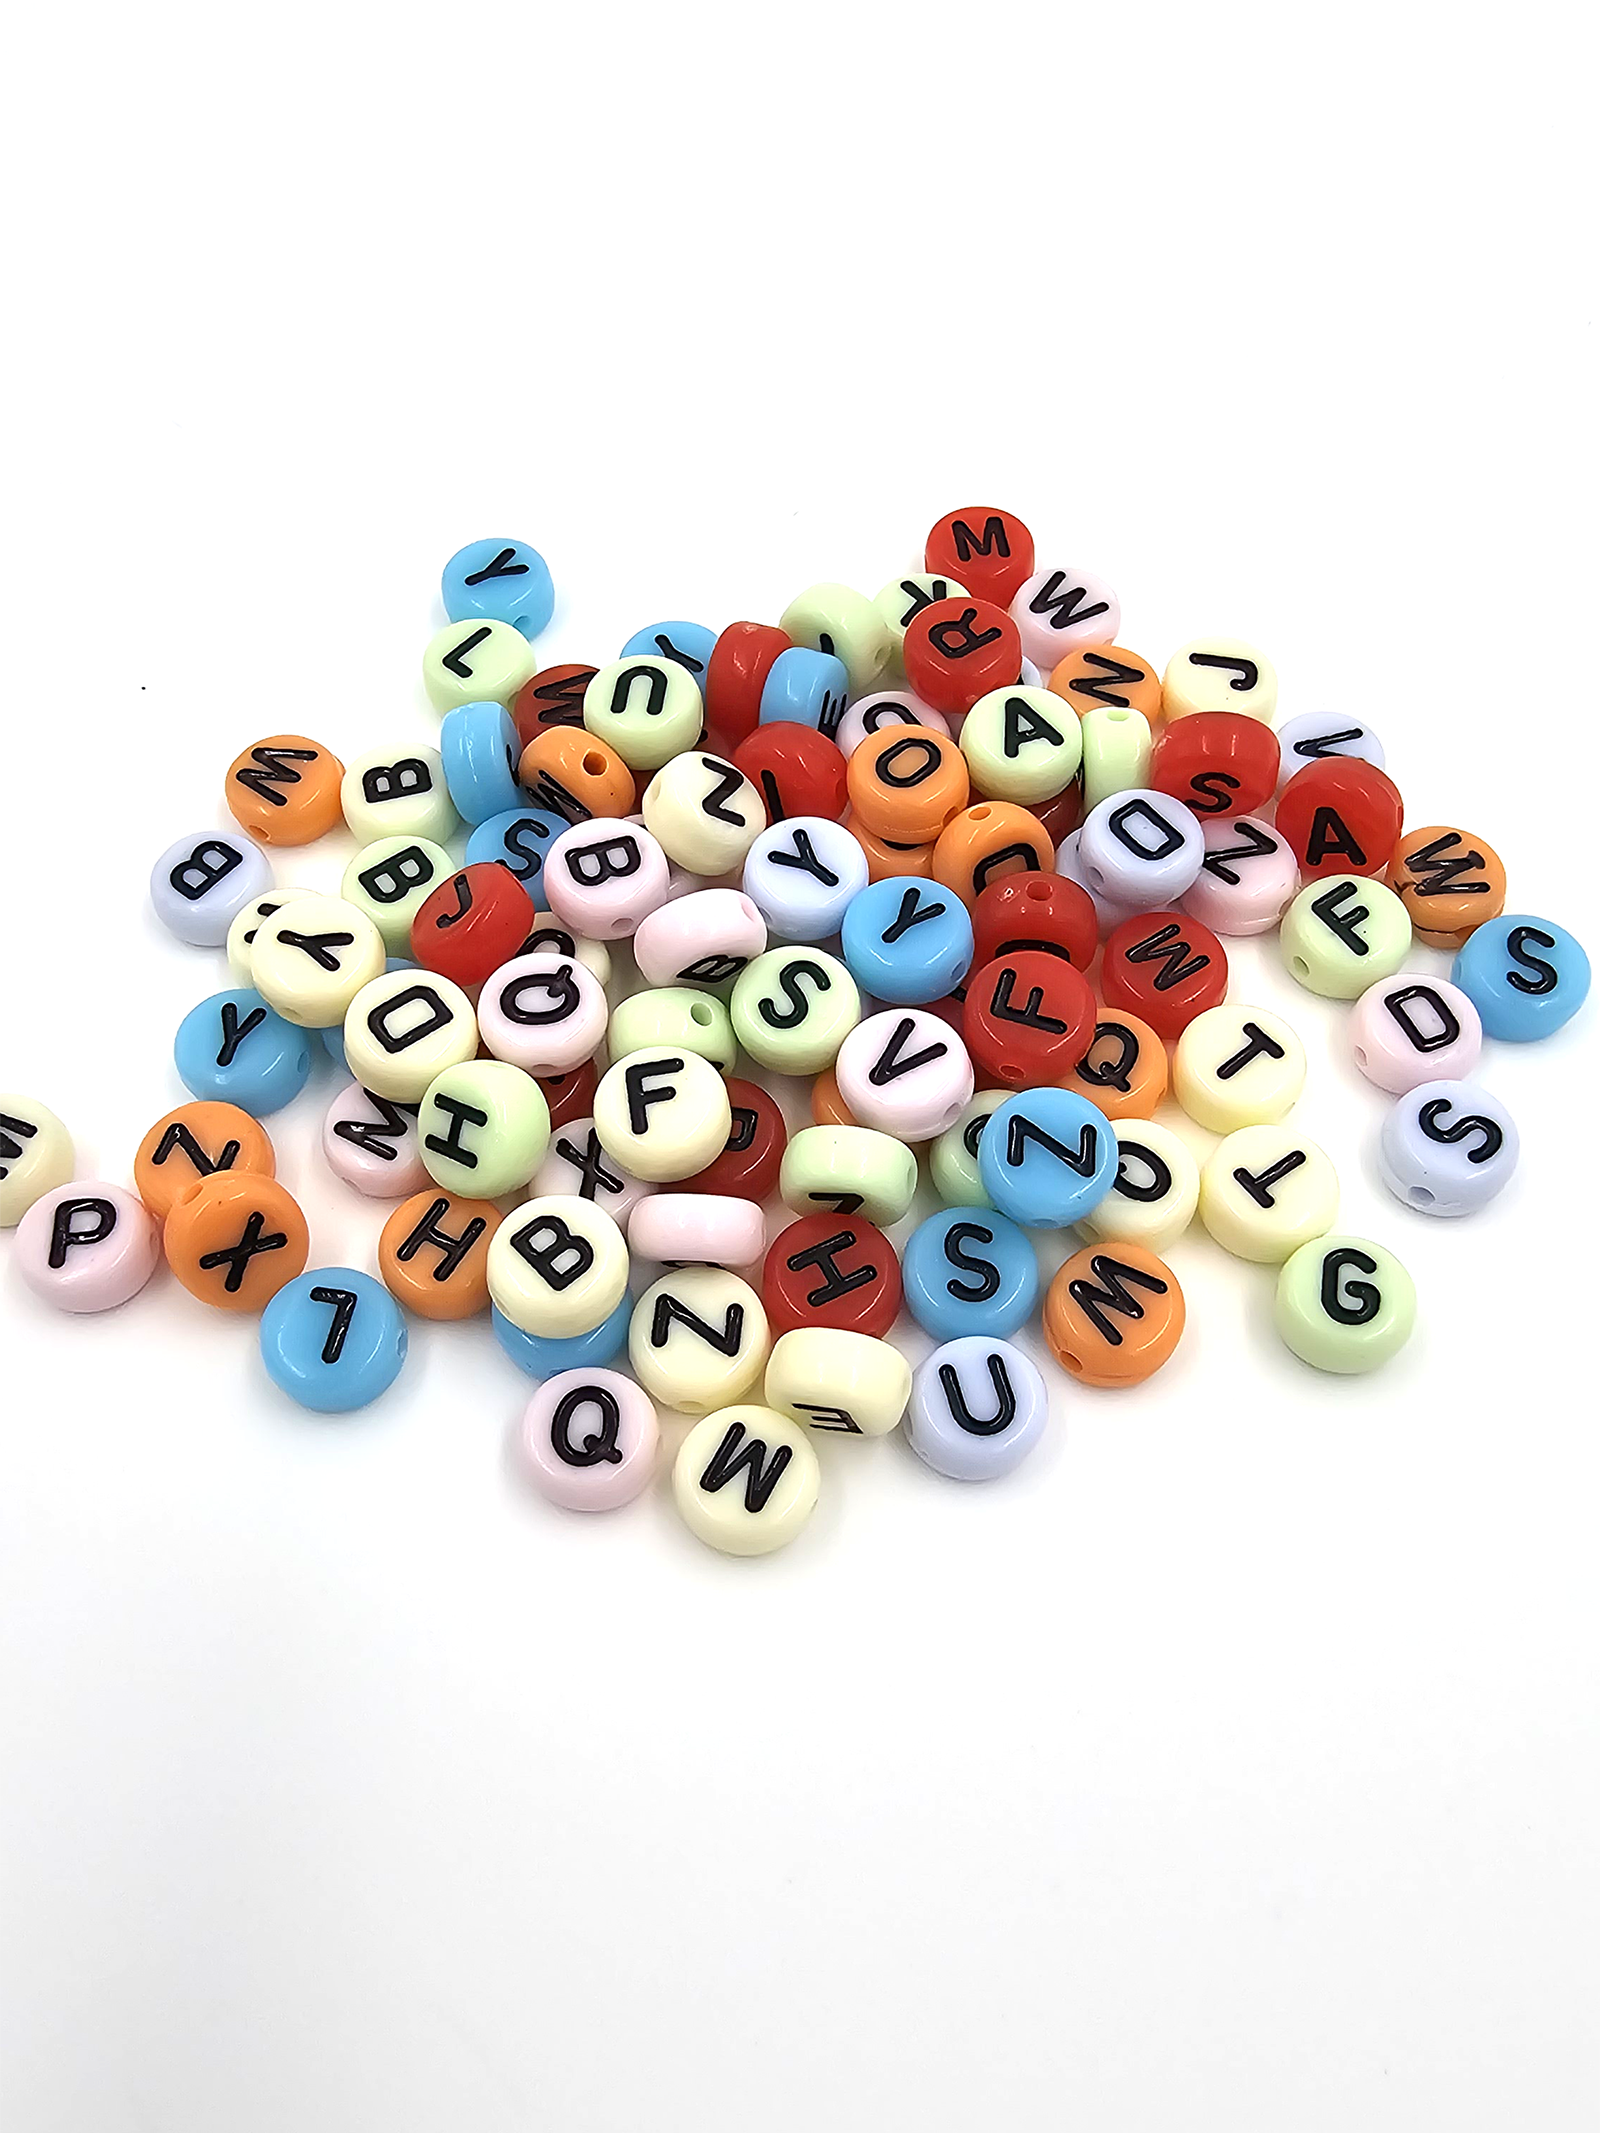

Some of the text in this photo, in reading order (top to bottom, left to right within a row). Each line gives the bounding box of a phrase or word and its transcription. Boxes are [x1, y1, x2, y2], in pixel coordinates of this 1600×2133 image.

[465, 548, 530, 586] Y
[443, 627, 492, 678] L
[929, 608, 1002, 659] R
[611, 666, 667, 715] U
[1189, 653, 1258, 691] J
[1005, 698, 1064, 758] A
[363, 759, 432, 803] B
[876, 738, 941, 787] O
[1186, 772, 1241, 813] S
[494, 819, 549, 882] S
[565, 836, 641, 886] B
[768, 829, 838, 886] Y
[1306, 807, 1367, 866] A
[170, 841, 242, 900] B
[358, 846, 433, 903] B
[436, 873, 473, 929] J
[882, 888, 945, 943] Y
[1312, 882, 1369, 956] F
[277, 930, 354, 971] Y
[1507, 927, 1557, 994] S
[500, 965, 580, 1025] Q
[758, 961, 831, 1029] S
[990, 969, 1067, 1034] F
[1384, 986, 1459, 1052] D
[217, 1003, 266, 1066] Y
[869, 1018, 947, 1086] V
[1075, 1022, 1140, 1092] Q
[1217, 1023, 1284, 1079] T
[625, 1058, 685, 1134] F
[425, 1093, 487, 1168] H
[1419, 1099, 1502, 1163] S
[556, 1127, 624, 1201] X
[1233, 1151, 1306, 1208] T
[48, 1198, 116, 1268] P
[200, 1212, 287, 1292] X
[397, 1198, 486, 1281] H
[510, 1216, 594, 1291] B
[944, 1223, 1000, 1302] S
[787, 1231, 877, 1307] H
[1321, 1248, 1381, 1325] G
[551, 1386, 622, 1467] Q
[939, 1354, 1016, 1436] U
